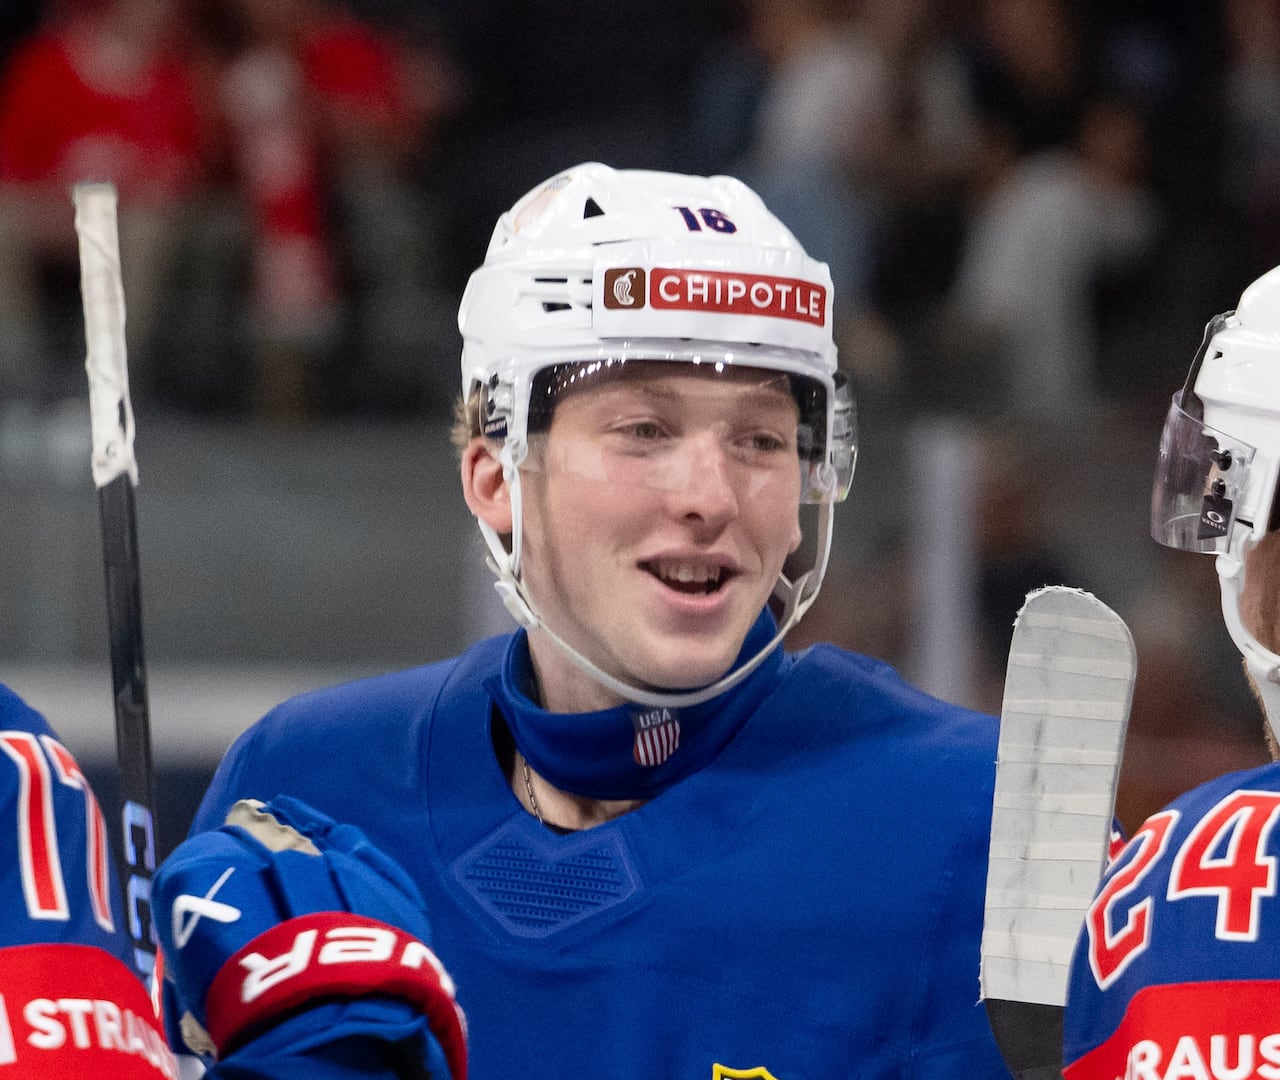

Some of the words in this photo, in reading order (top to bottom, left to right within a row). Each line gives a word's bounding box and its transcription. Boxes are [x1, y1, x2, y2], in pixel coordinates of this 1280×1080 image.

[672, 206, 738, 234] 16
[658, 274, 822, 319] CHIPOTLE
[639, 708, 671, 729] USA
[122, 800, 158, 994] CC
[237, 926, 460, 1004] UER
